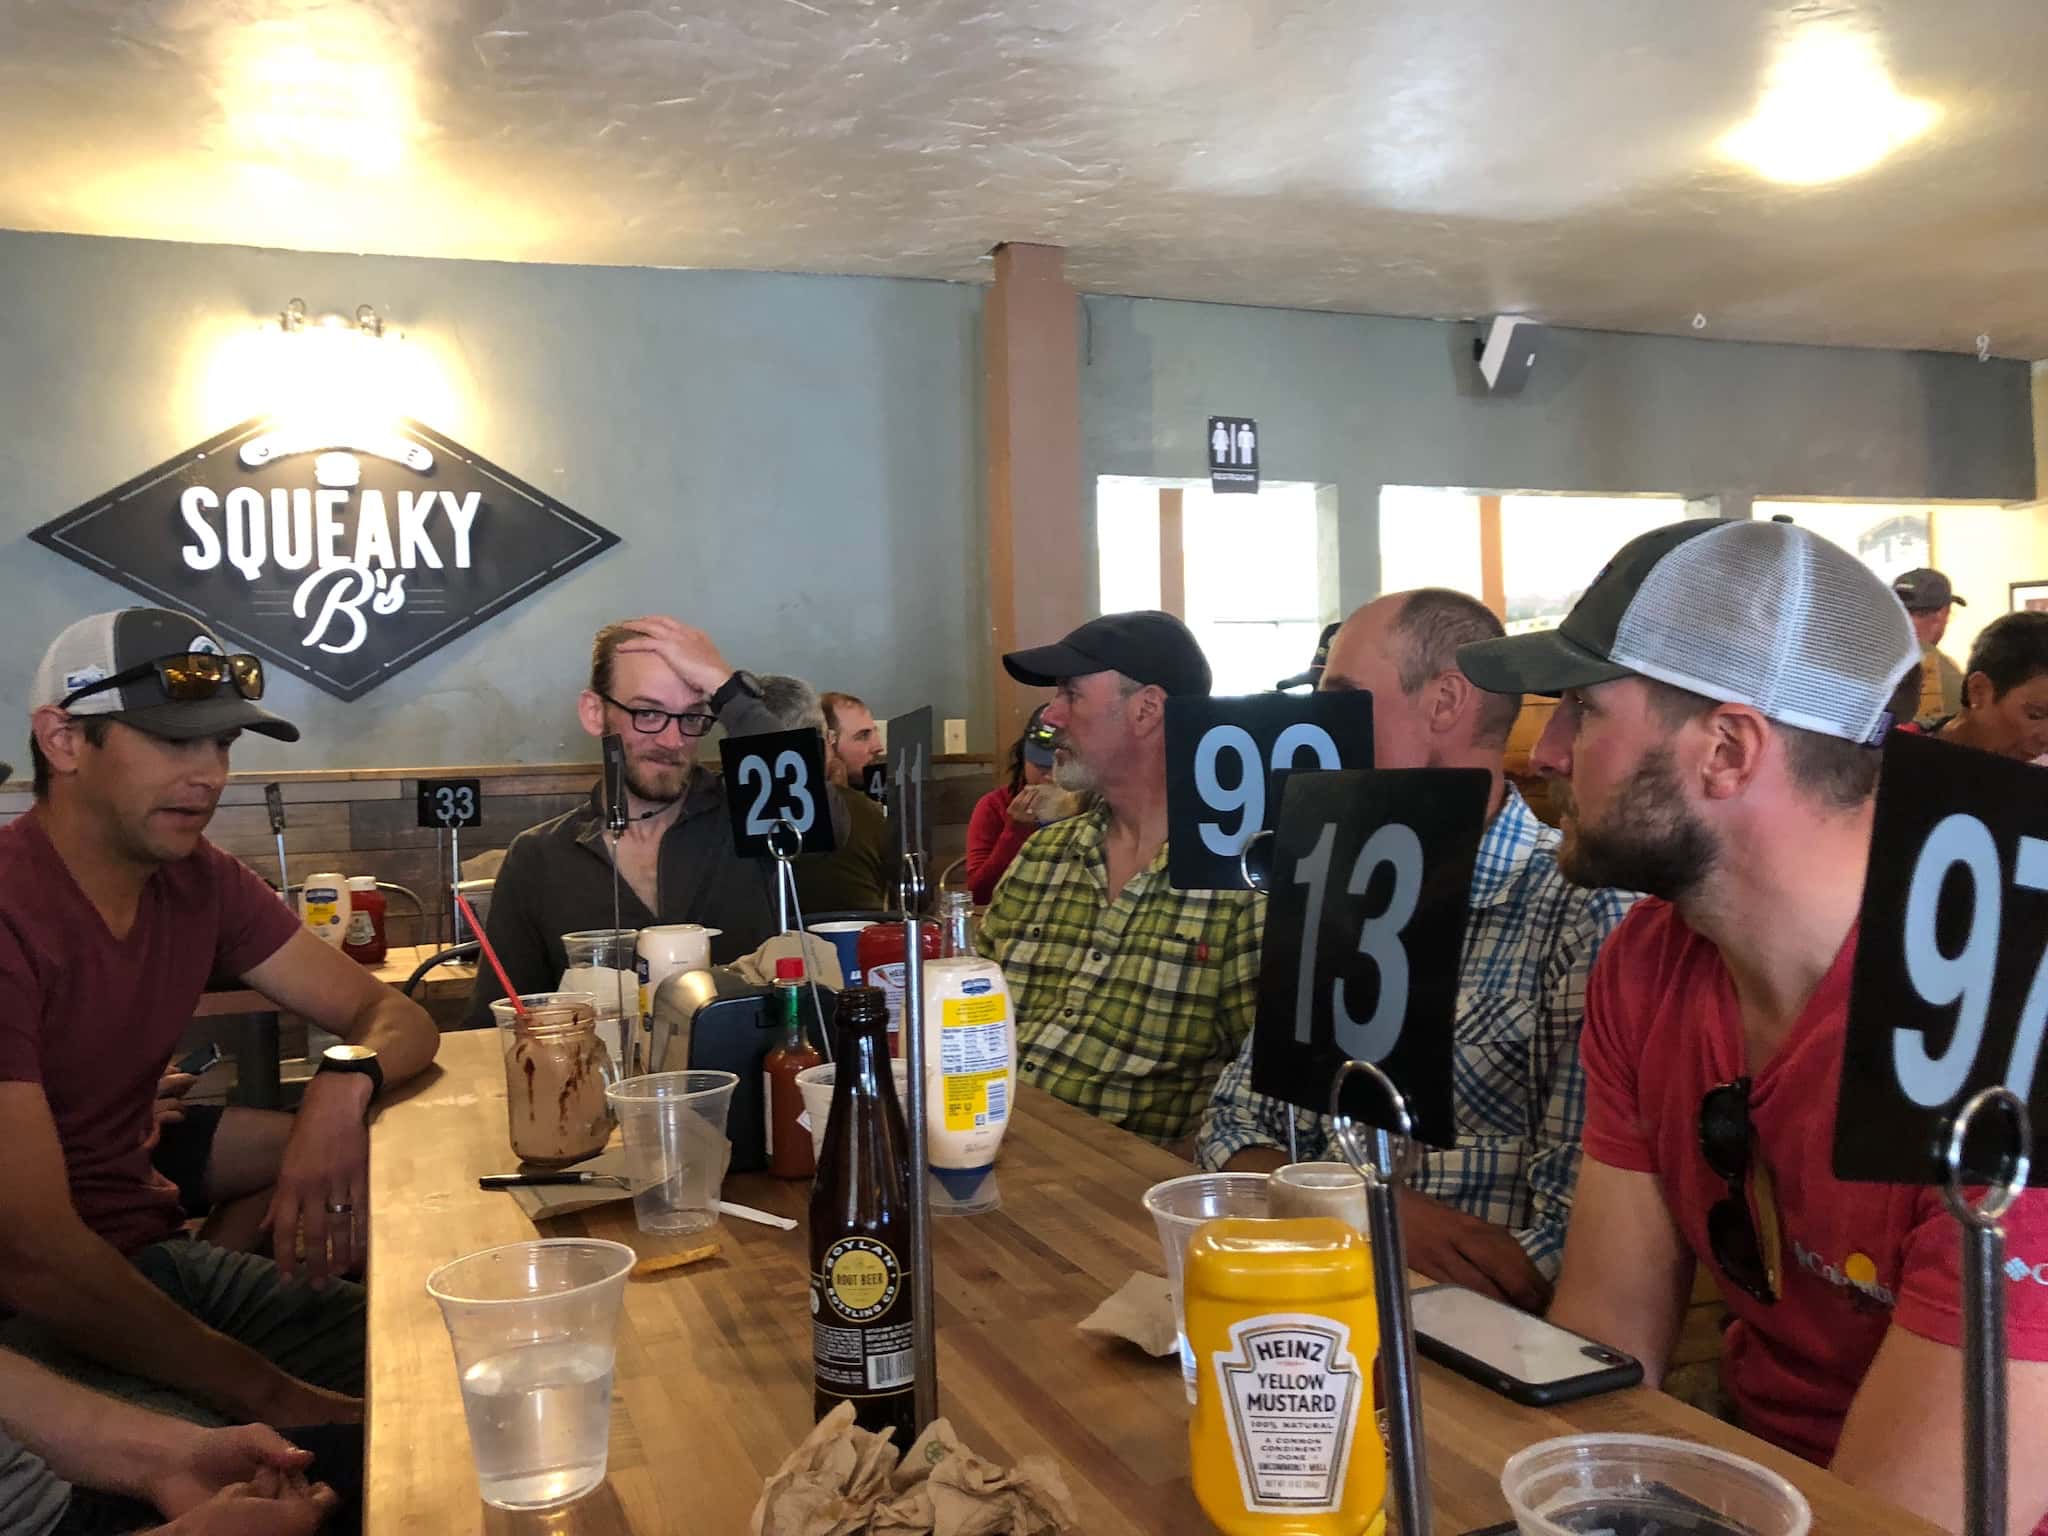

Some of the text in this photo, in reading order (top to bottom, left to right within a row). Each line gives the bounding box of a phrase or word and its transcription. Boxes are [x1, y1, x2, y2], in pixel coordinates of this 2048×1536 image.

[180, 486, 482, 581] SQUEAKY
[292, 565, 406, 655] B's
[436, 787, 475, 820] 33
[738, 750, 815, 836] 23
[1294, 822, 1424, 1064] 13
[836, 1273, 884, 1286] ROOT BEER
[1256, 1340, 1326, 1362] HEINZ
[1257, 1373, 1326, 1391] YELLOW
[1247, 1393, 1337, 1413] MUSTARD
[1283, 1422, 1334, 1430] NATURAL
